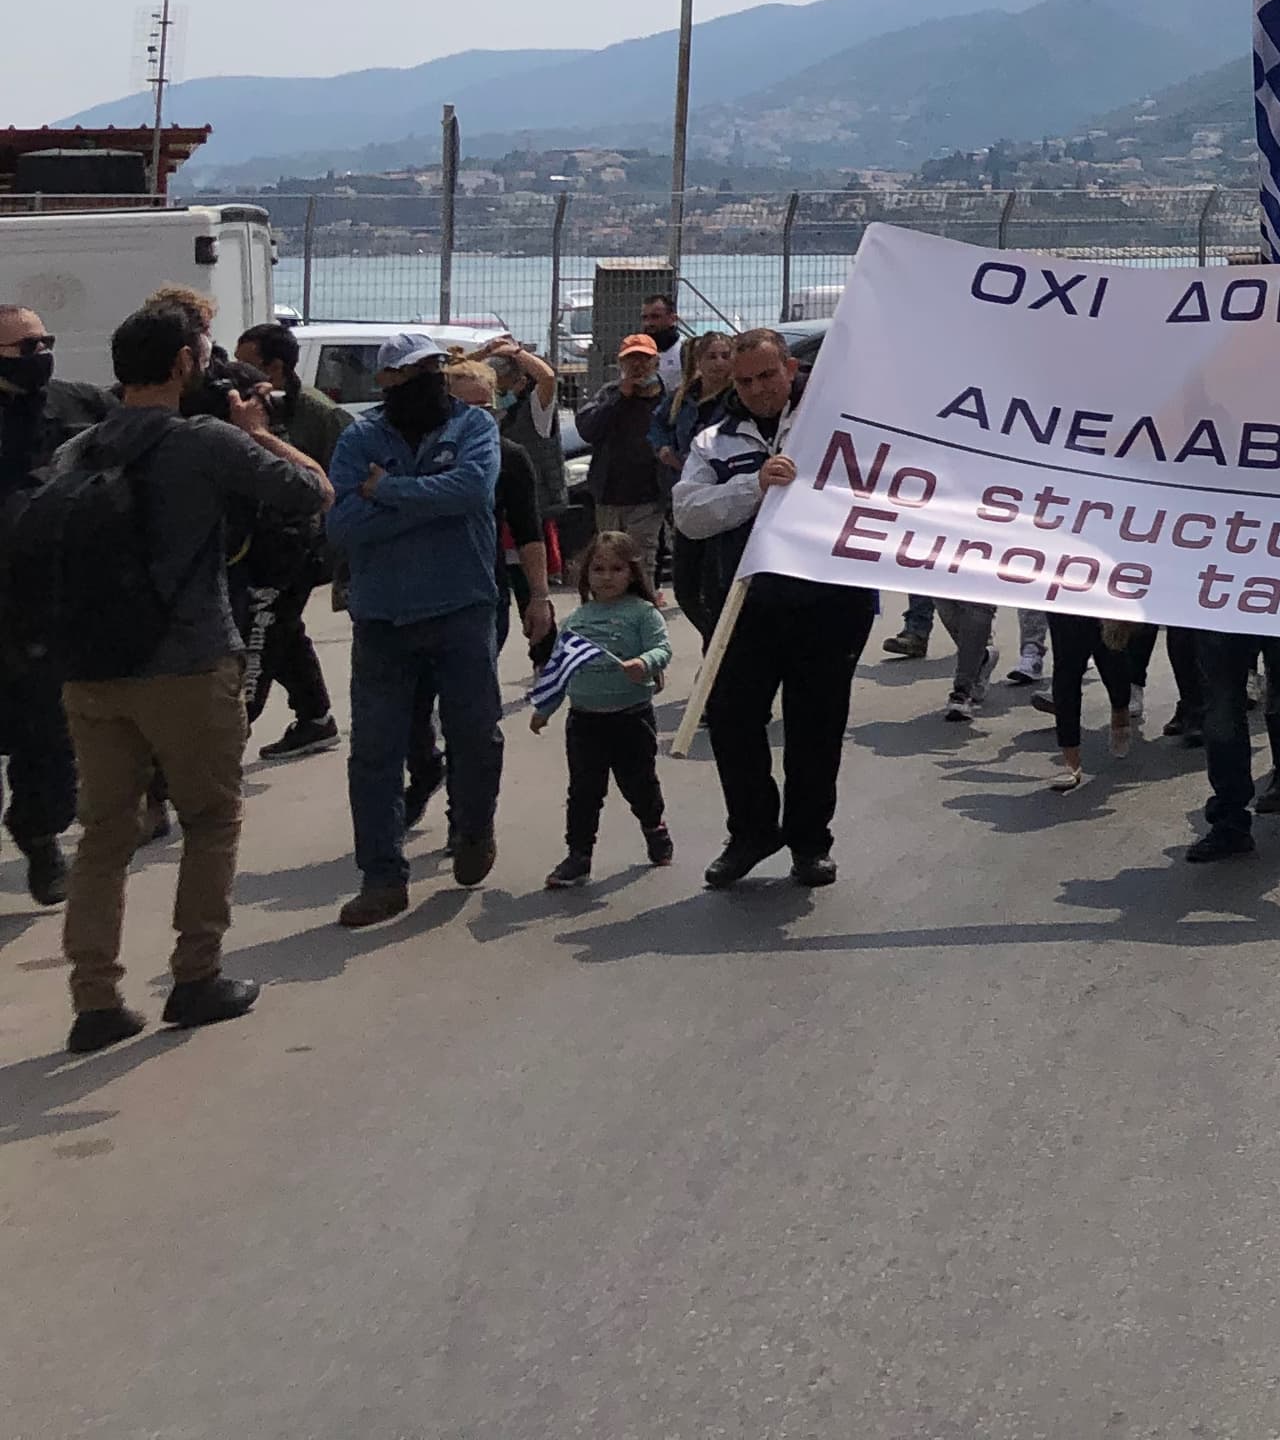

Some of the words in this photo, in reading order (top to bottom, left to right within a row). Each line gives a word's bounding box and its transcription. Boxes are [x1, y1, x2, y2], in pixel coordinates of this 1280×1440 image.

[971, 262, 1108, 317] ΟΧΙ
[813, 430, 937, 508] No
[831, 506, 1152, 601] Europe
